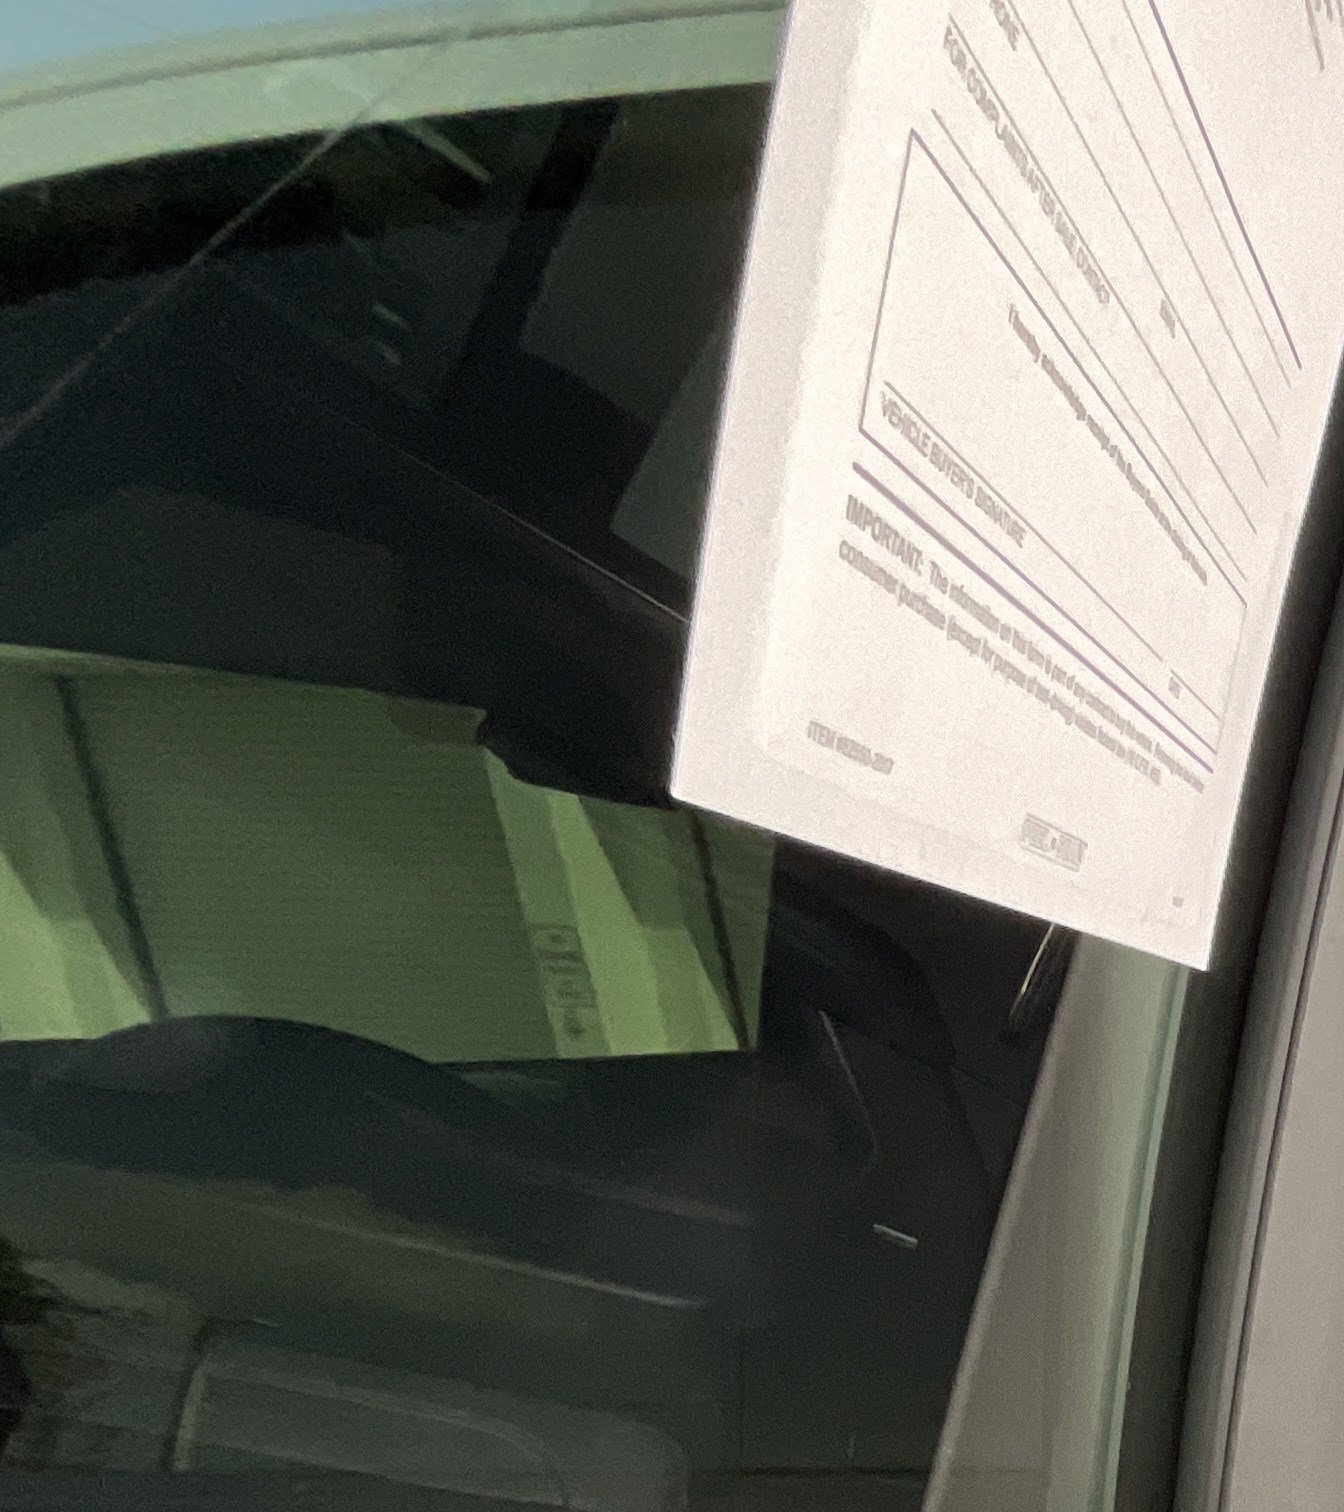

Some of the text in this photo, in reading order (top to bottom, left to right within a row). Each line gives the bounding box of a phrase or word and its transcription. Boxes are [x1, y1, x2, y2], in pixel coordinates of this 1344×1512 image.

[879, 391, 930, 458] VEHICLE
[839, 539, 897, 595] consumer
[897, 581, 945, 634] purchase
[846, 494, 924, 574] IMPORTANT:
[927, 560, 949, 594] The
